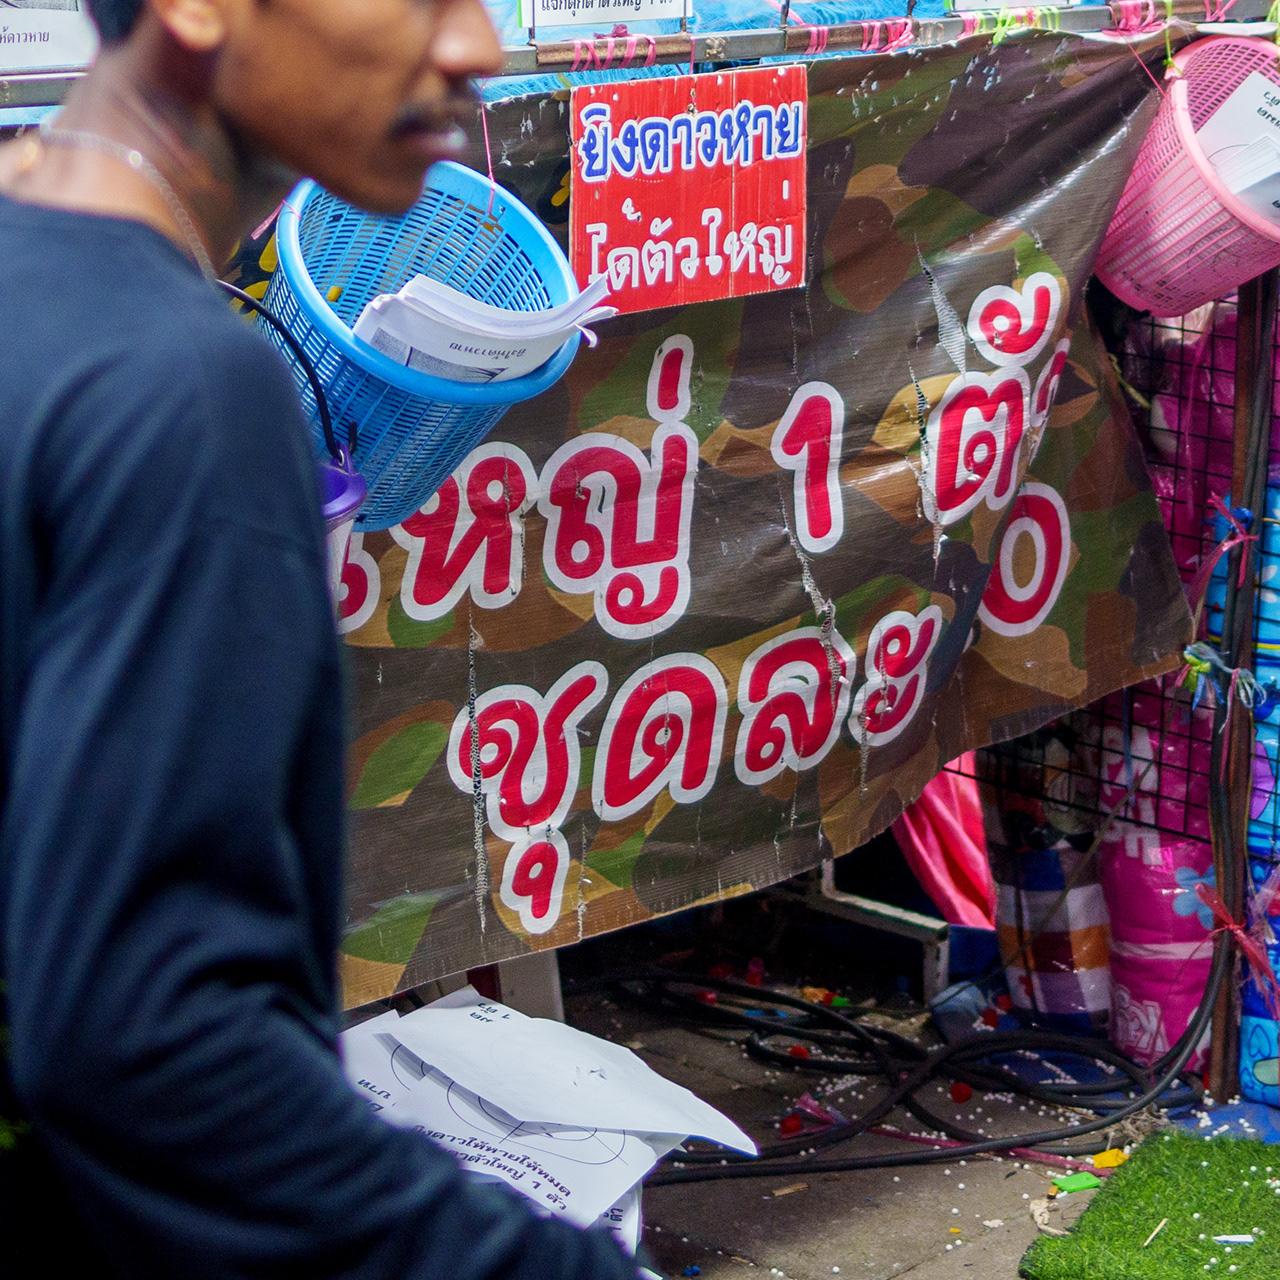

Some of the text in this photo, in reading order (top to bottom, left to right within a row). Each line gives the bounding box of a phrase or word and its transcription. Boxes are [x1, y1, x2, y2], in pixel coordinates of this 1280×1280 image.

[577, 99, 804, 183] ยิงดาวหาย
[585, 180, 792, 291] ได้ตัวใหญ่
[770, 380, 846, 554] 1
[448, 604, 943, 934] ชุดละ
[962, 481, 1072, 656] 0
[447, 1149, 527, 1182] าตัวใหญ่
[545, 1191, 568, 1211] ตัว
